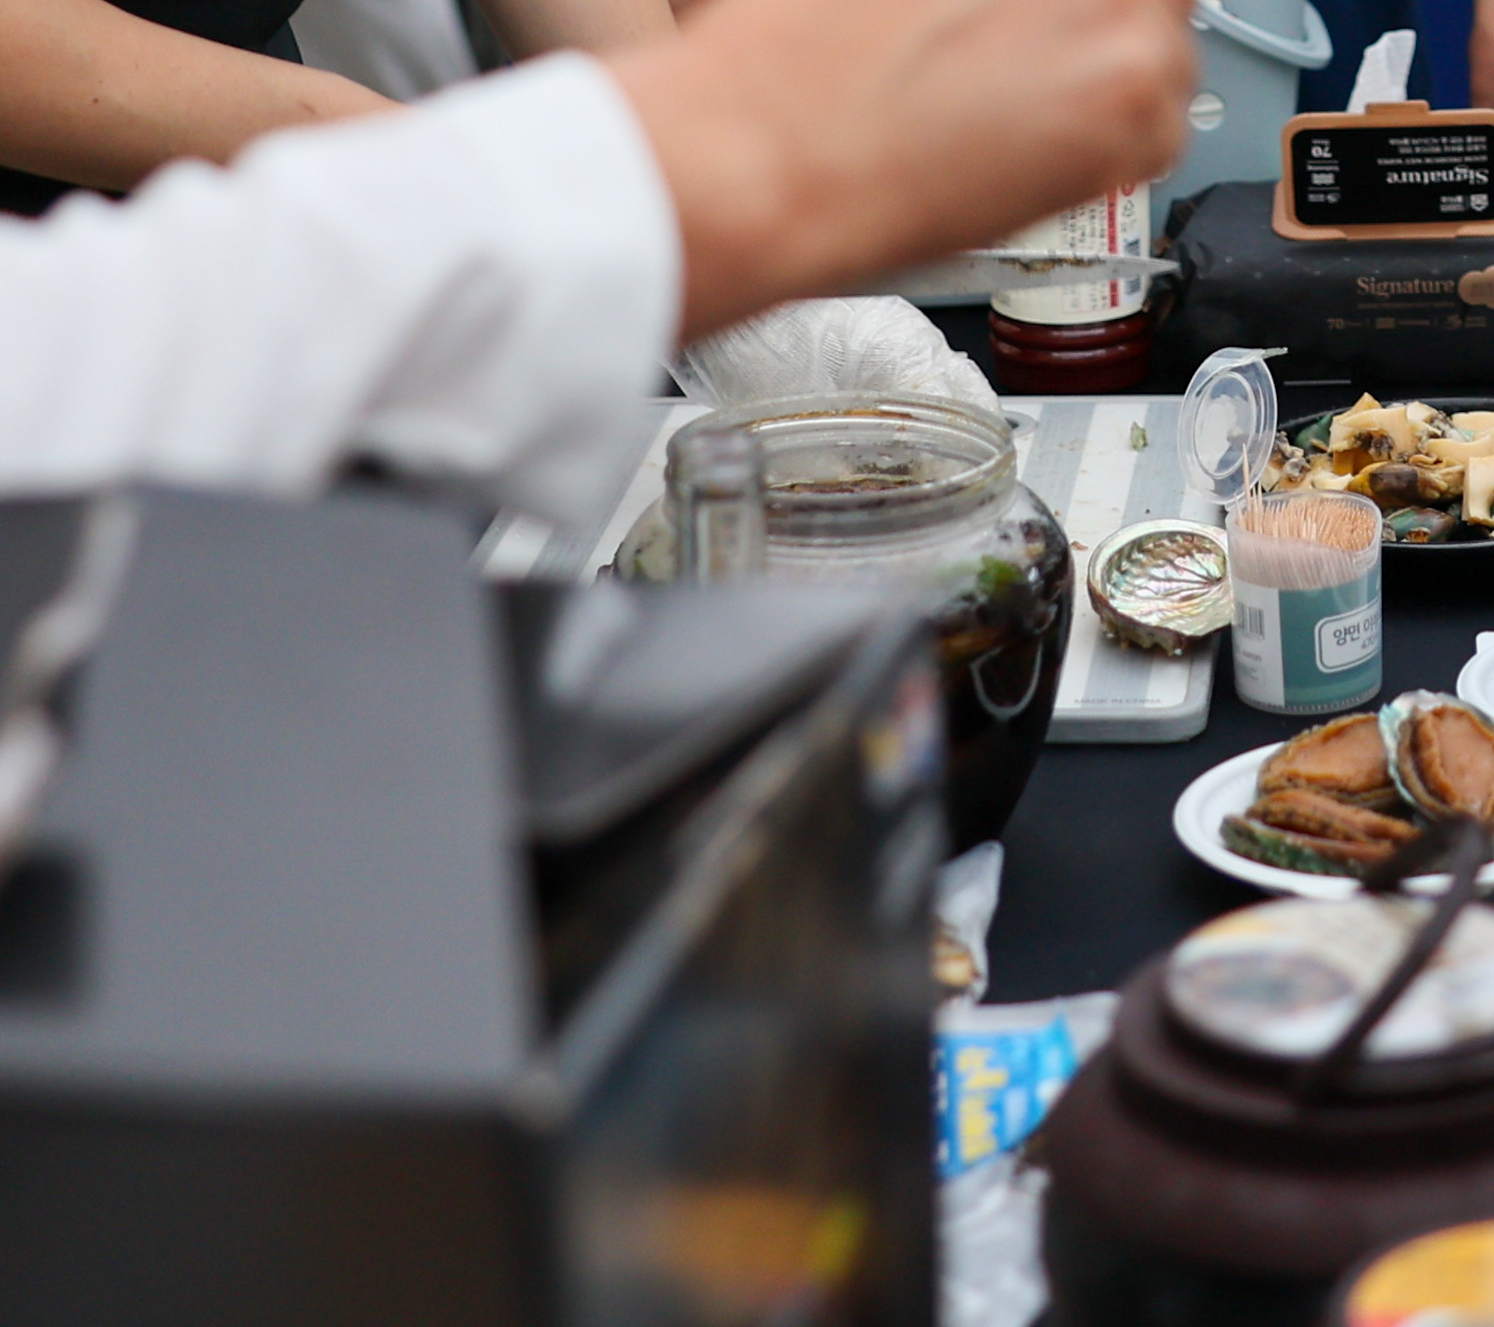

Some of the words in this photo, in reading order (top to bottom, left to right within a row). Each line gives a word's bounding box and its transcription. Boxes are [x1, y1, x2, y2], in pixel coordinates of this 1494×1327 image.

[1311, 146, 1333, 159] 70
[1386, 164, 1489, 186] Signature
[1356, 276, 1456, 298] Signature
[1332, 621, 1361, 647] 양면
